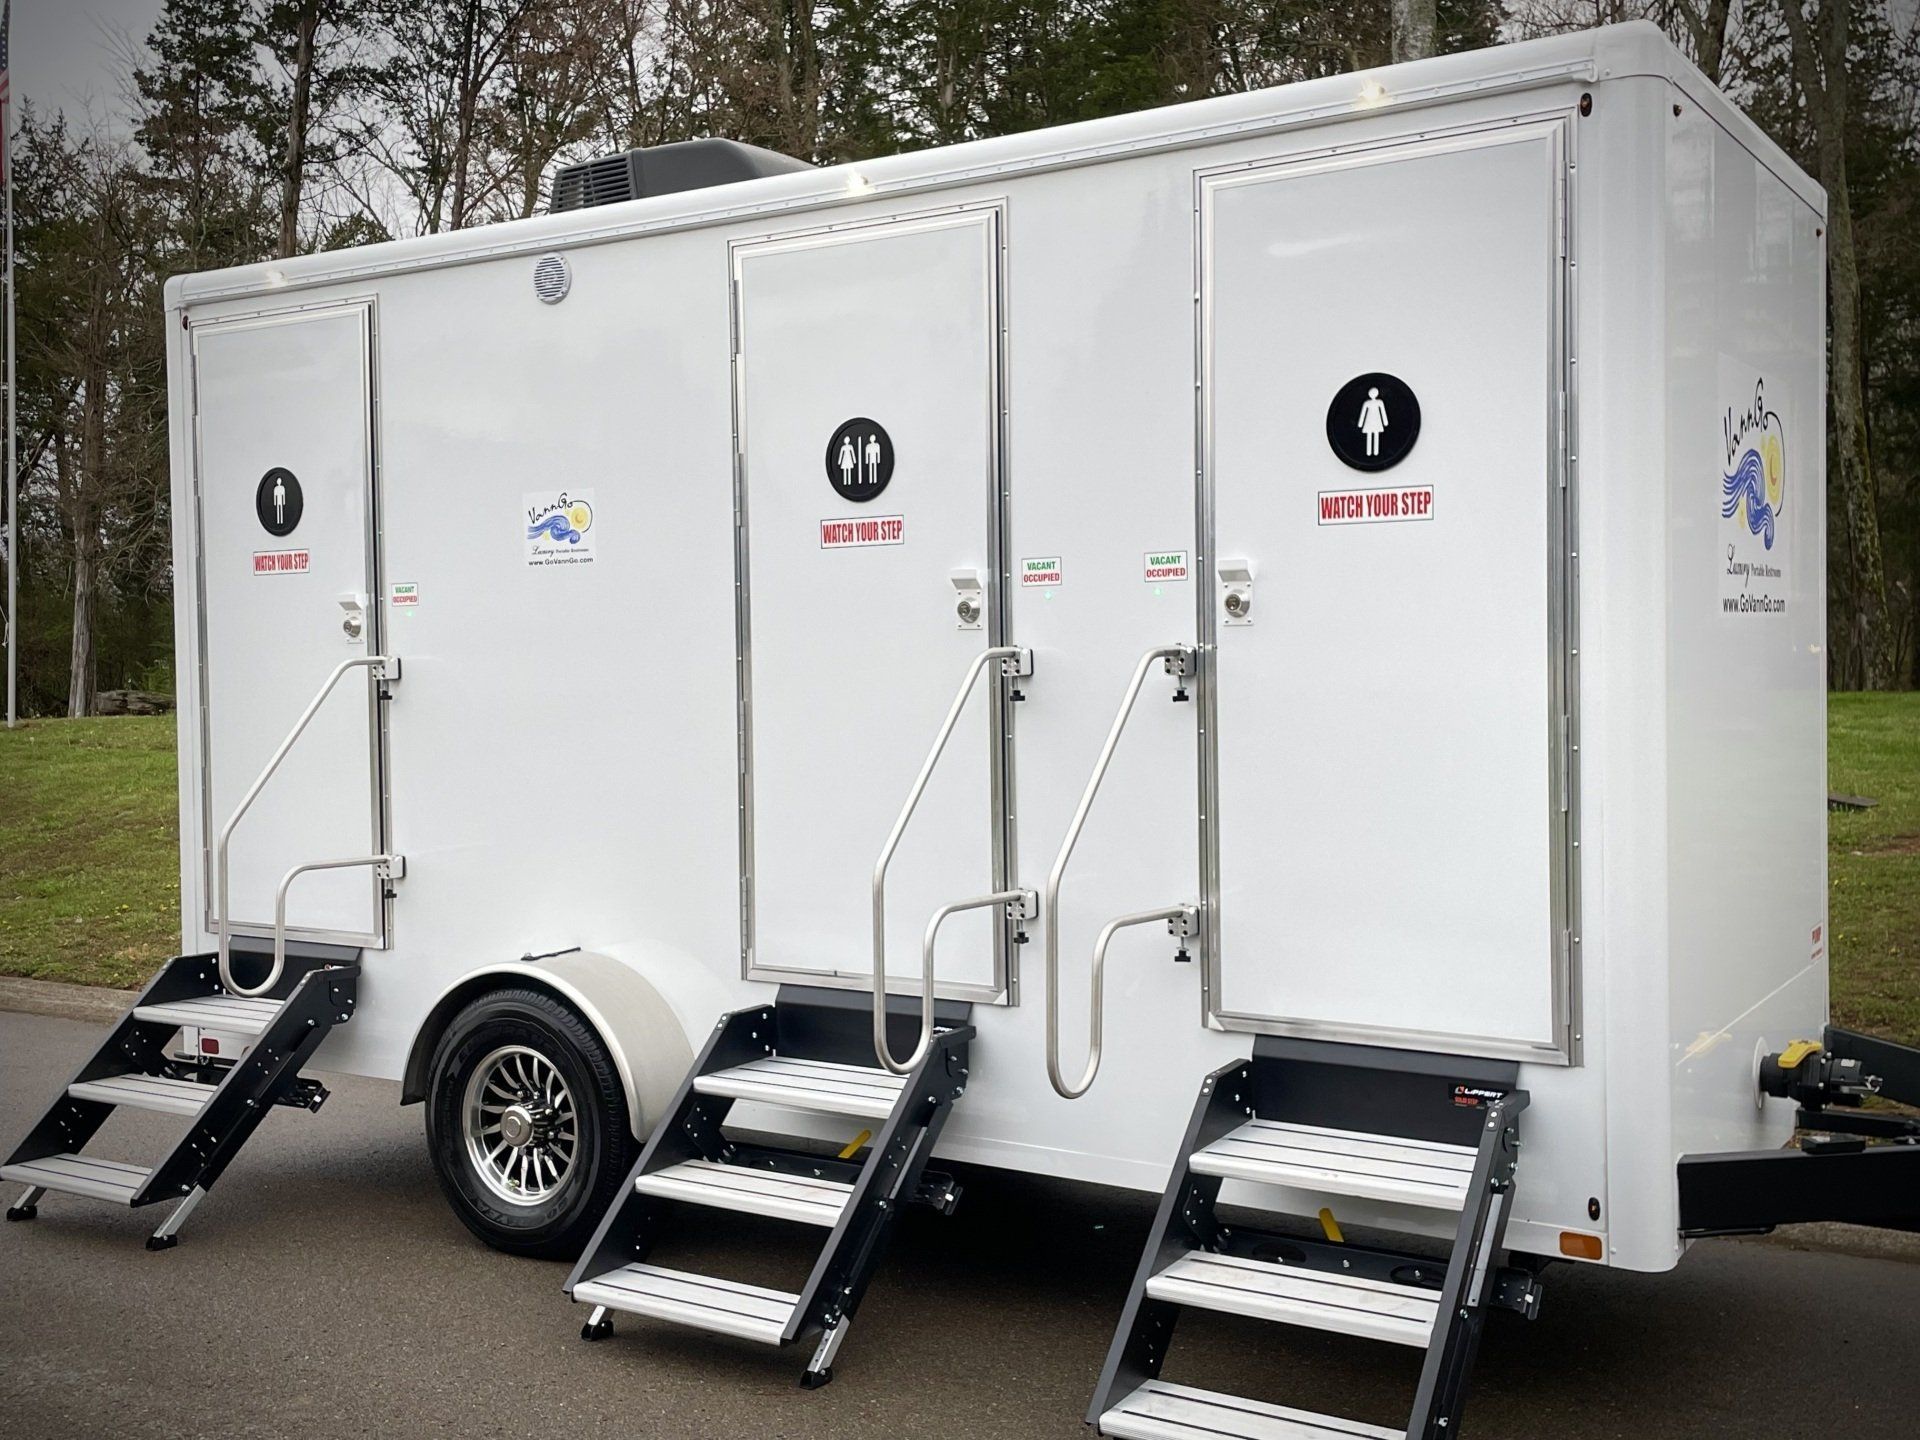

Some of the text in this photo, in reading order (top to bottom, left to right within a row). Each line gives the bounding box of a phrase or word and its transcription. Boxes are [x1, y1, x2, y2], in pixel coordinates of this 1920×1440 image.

[1724, 377, 1773, 474] VannGo
[528, 492, 578, 526] VannGo
[1321, 491, 1431, 520] WATCH YOUR STEP
[823, 519, 903, 543] WATCH YOUR STEP
[255, 552, 308, 572] WATCH YOUR STEP
[1026, 561, 1056, 571] VACANT
[1150, 555, 1181, 566] VACANT
[1023, 572, 1060, 583] OCCUPIED
[1146, 567, 1186, 578] OCCUPIED
[395, 586, 414, 594] VACANT
[393, 595, 418, 603] OCCUPIED
[1722, 592, 1786, 613] www.GoVannGo.com
